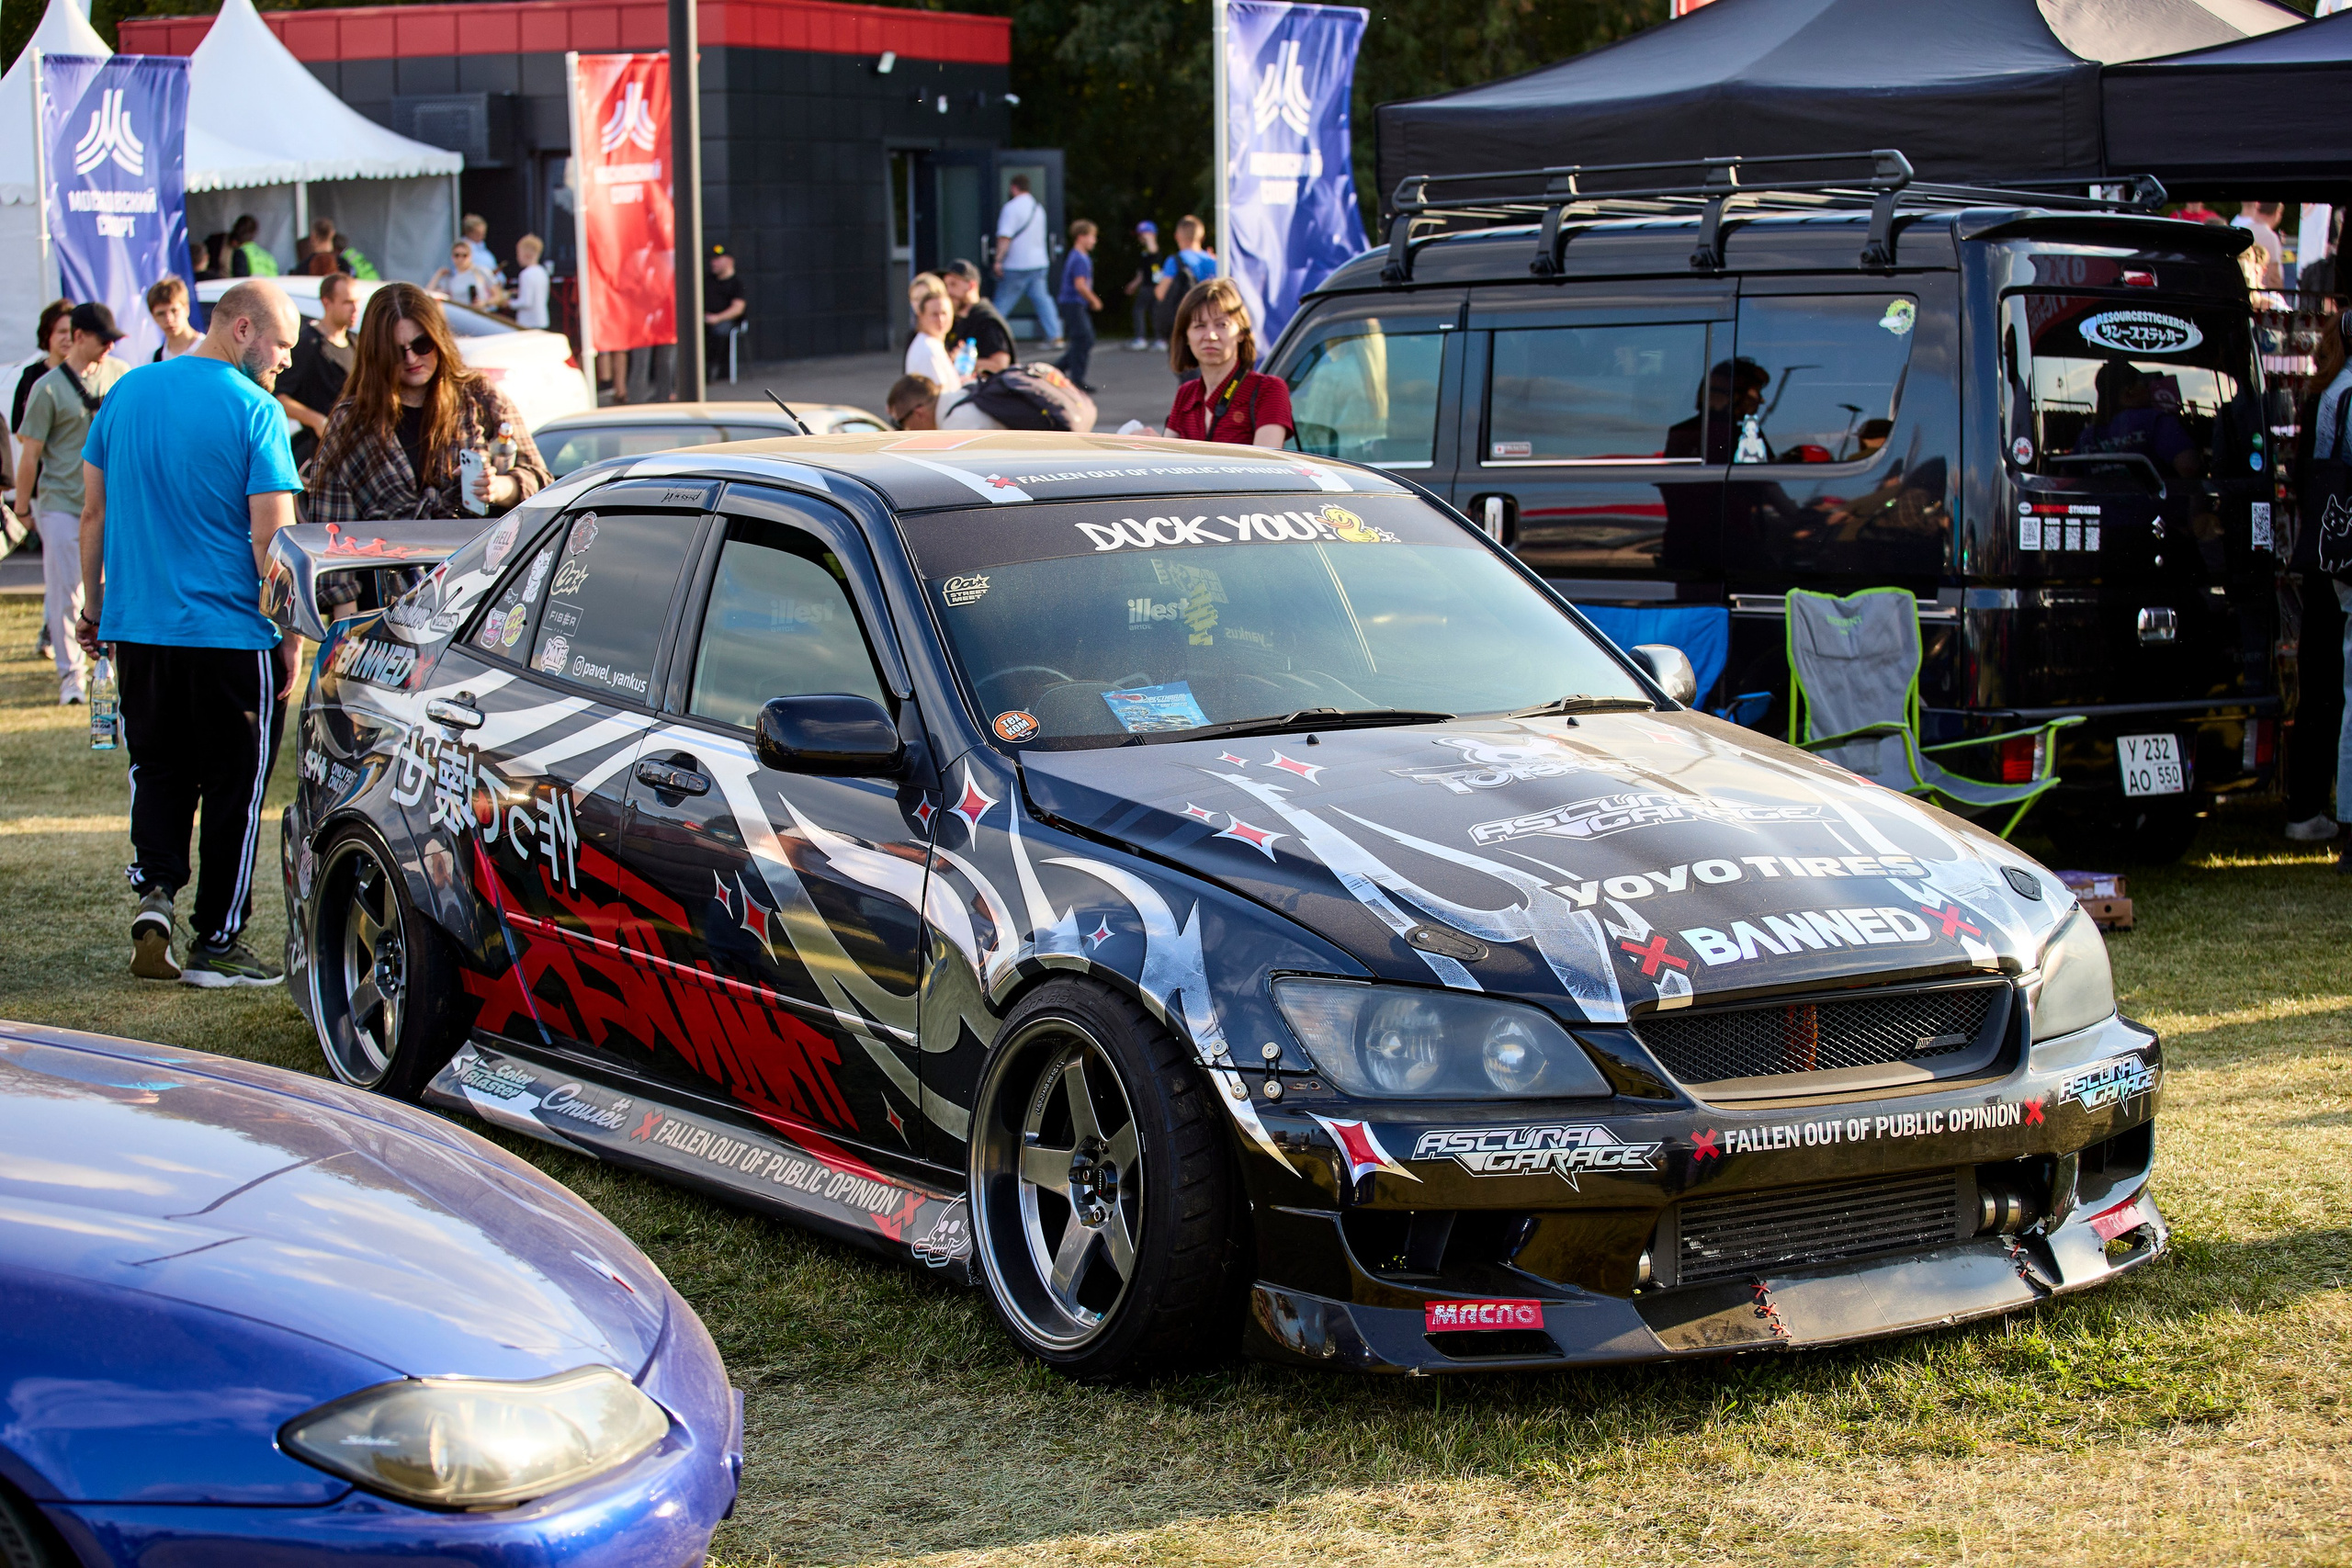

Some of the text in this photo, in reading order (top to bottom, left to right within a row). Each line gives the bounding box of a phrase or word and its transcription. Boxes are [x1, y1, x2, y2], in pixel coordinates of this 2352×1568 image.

[1016, 466, 1295, 485] FALLEN OUT OF PUBLIC OPINION
[492, 530, 512, 546] HELL
[1074, 515, 1232, 551] DUCK
[950, 589, 988, 598] STREET
[952, 593, 981, 603] MEET
[335, 636, 415, 687] BANNED
[2143, 738, 2170, 761] 232
[331, 761, 347, 780] ONLY
[2157, 765, 2179, 784] 550
[1477, 794, 1716, 842] ASCURA
[1679, 906, 1931, 966] BANNED
[461, 1070, 523, 1099] Blaster
[495, 1065, 537, 1085] Color
[2060, 1056, 2134, 1099] ASCURA
[1417, 1126, 1591, 1154] ASCURA
[1724, 1102, 2021, 1155] FALLEN OUT OF PUBLIC OPINION
[652, 1119, 902, 1215] FALLEN OUT OF PUBLIC OPINION
[1484, 1145, 1652, 1175] GARAGE
